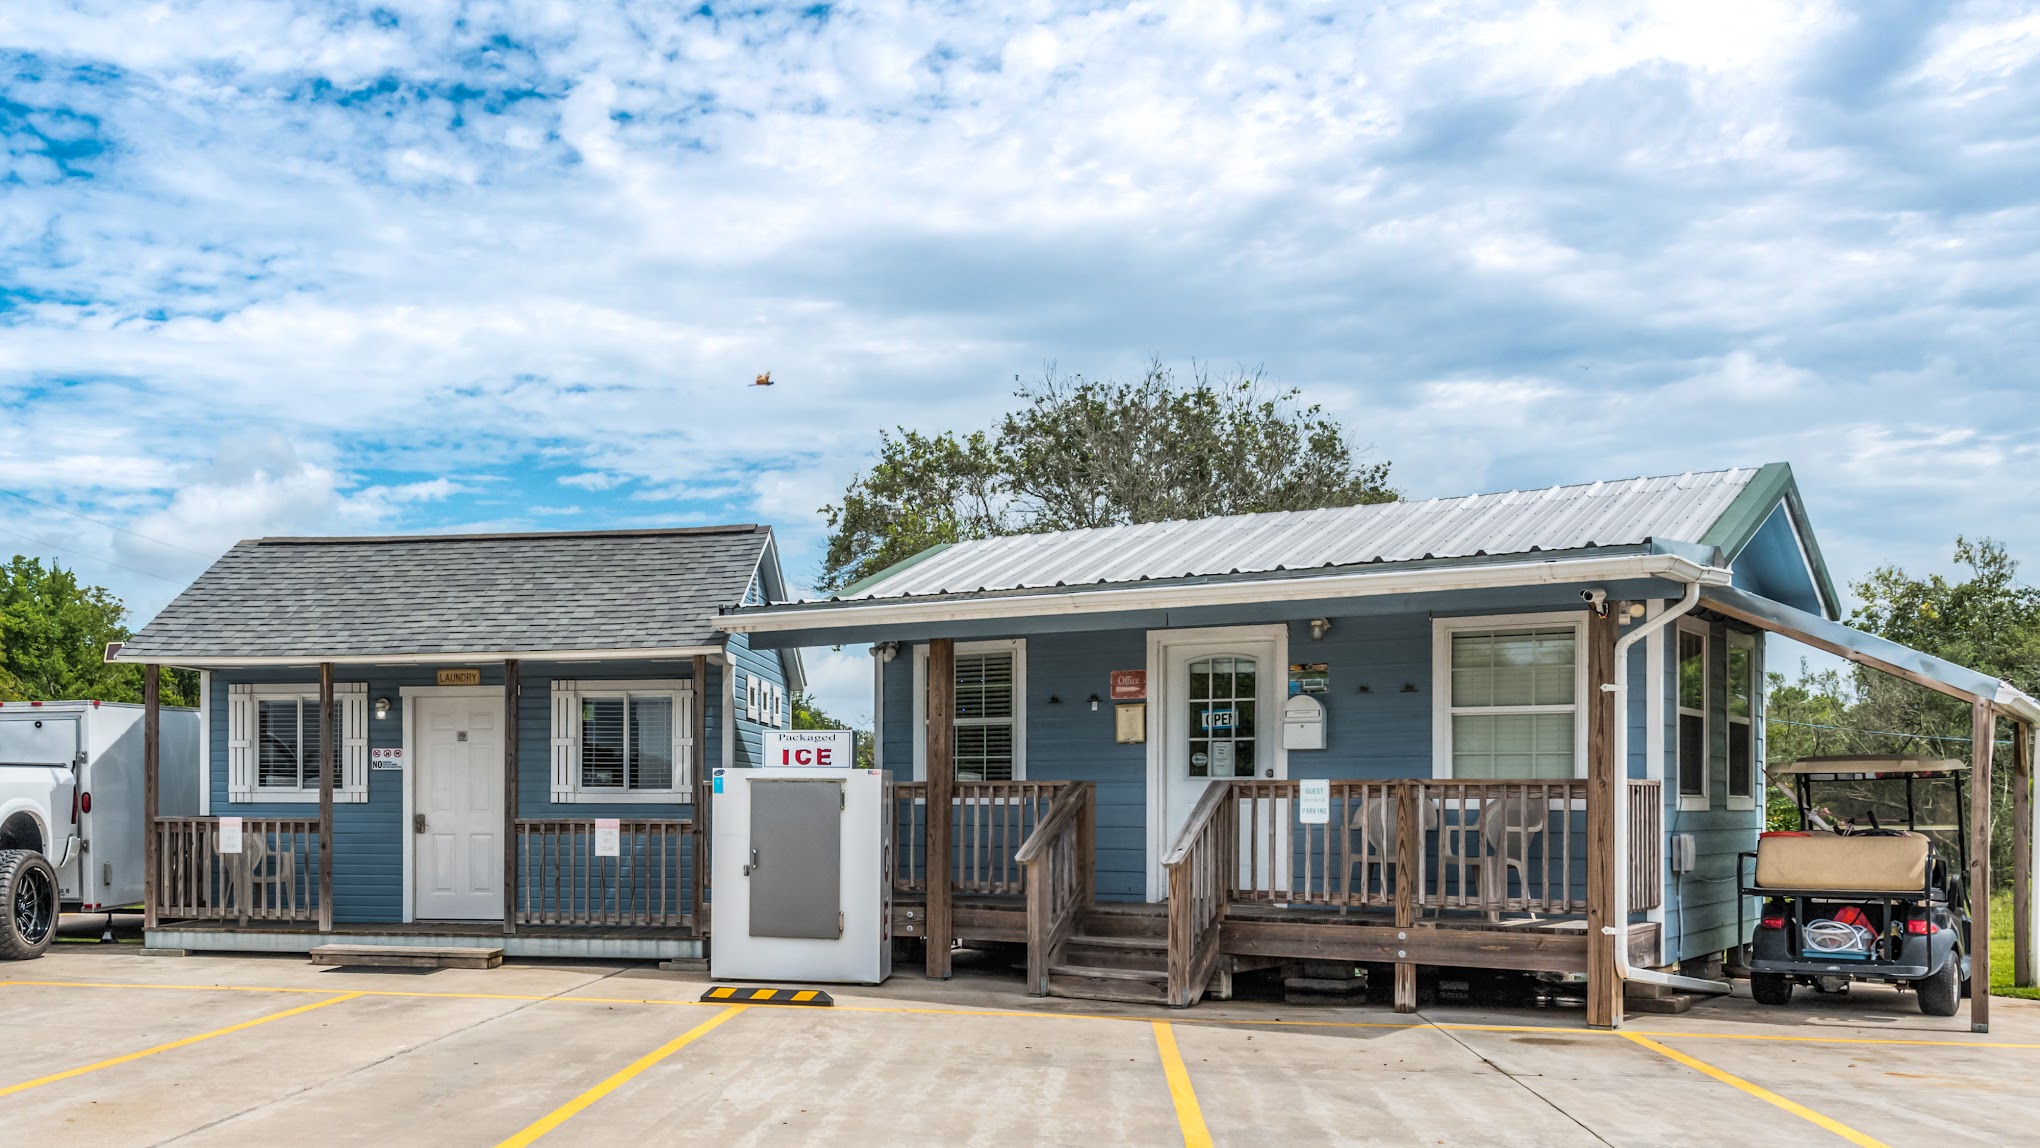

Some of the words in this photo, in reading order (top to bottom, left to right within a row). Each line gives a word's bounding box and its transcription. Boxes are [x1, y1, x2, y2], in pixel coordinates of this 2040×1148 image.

[439, 673, 477, 683] LAUNDRY
[1117, 675, 1140, 685] Office
[778, 733, 836, 743] Packaged
[782, 748, 832, 766] ICE
[372, 760, 383, 769] NO
[1305, 787, 1324, 795] GUEST
[1301, 807, 1328, 815] PARKING
